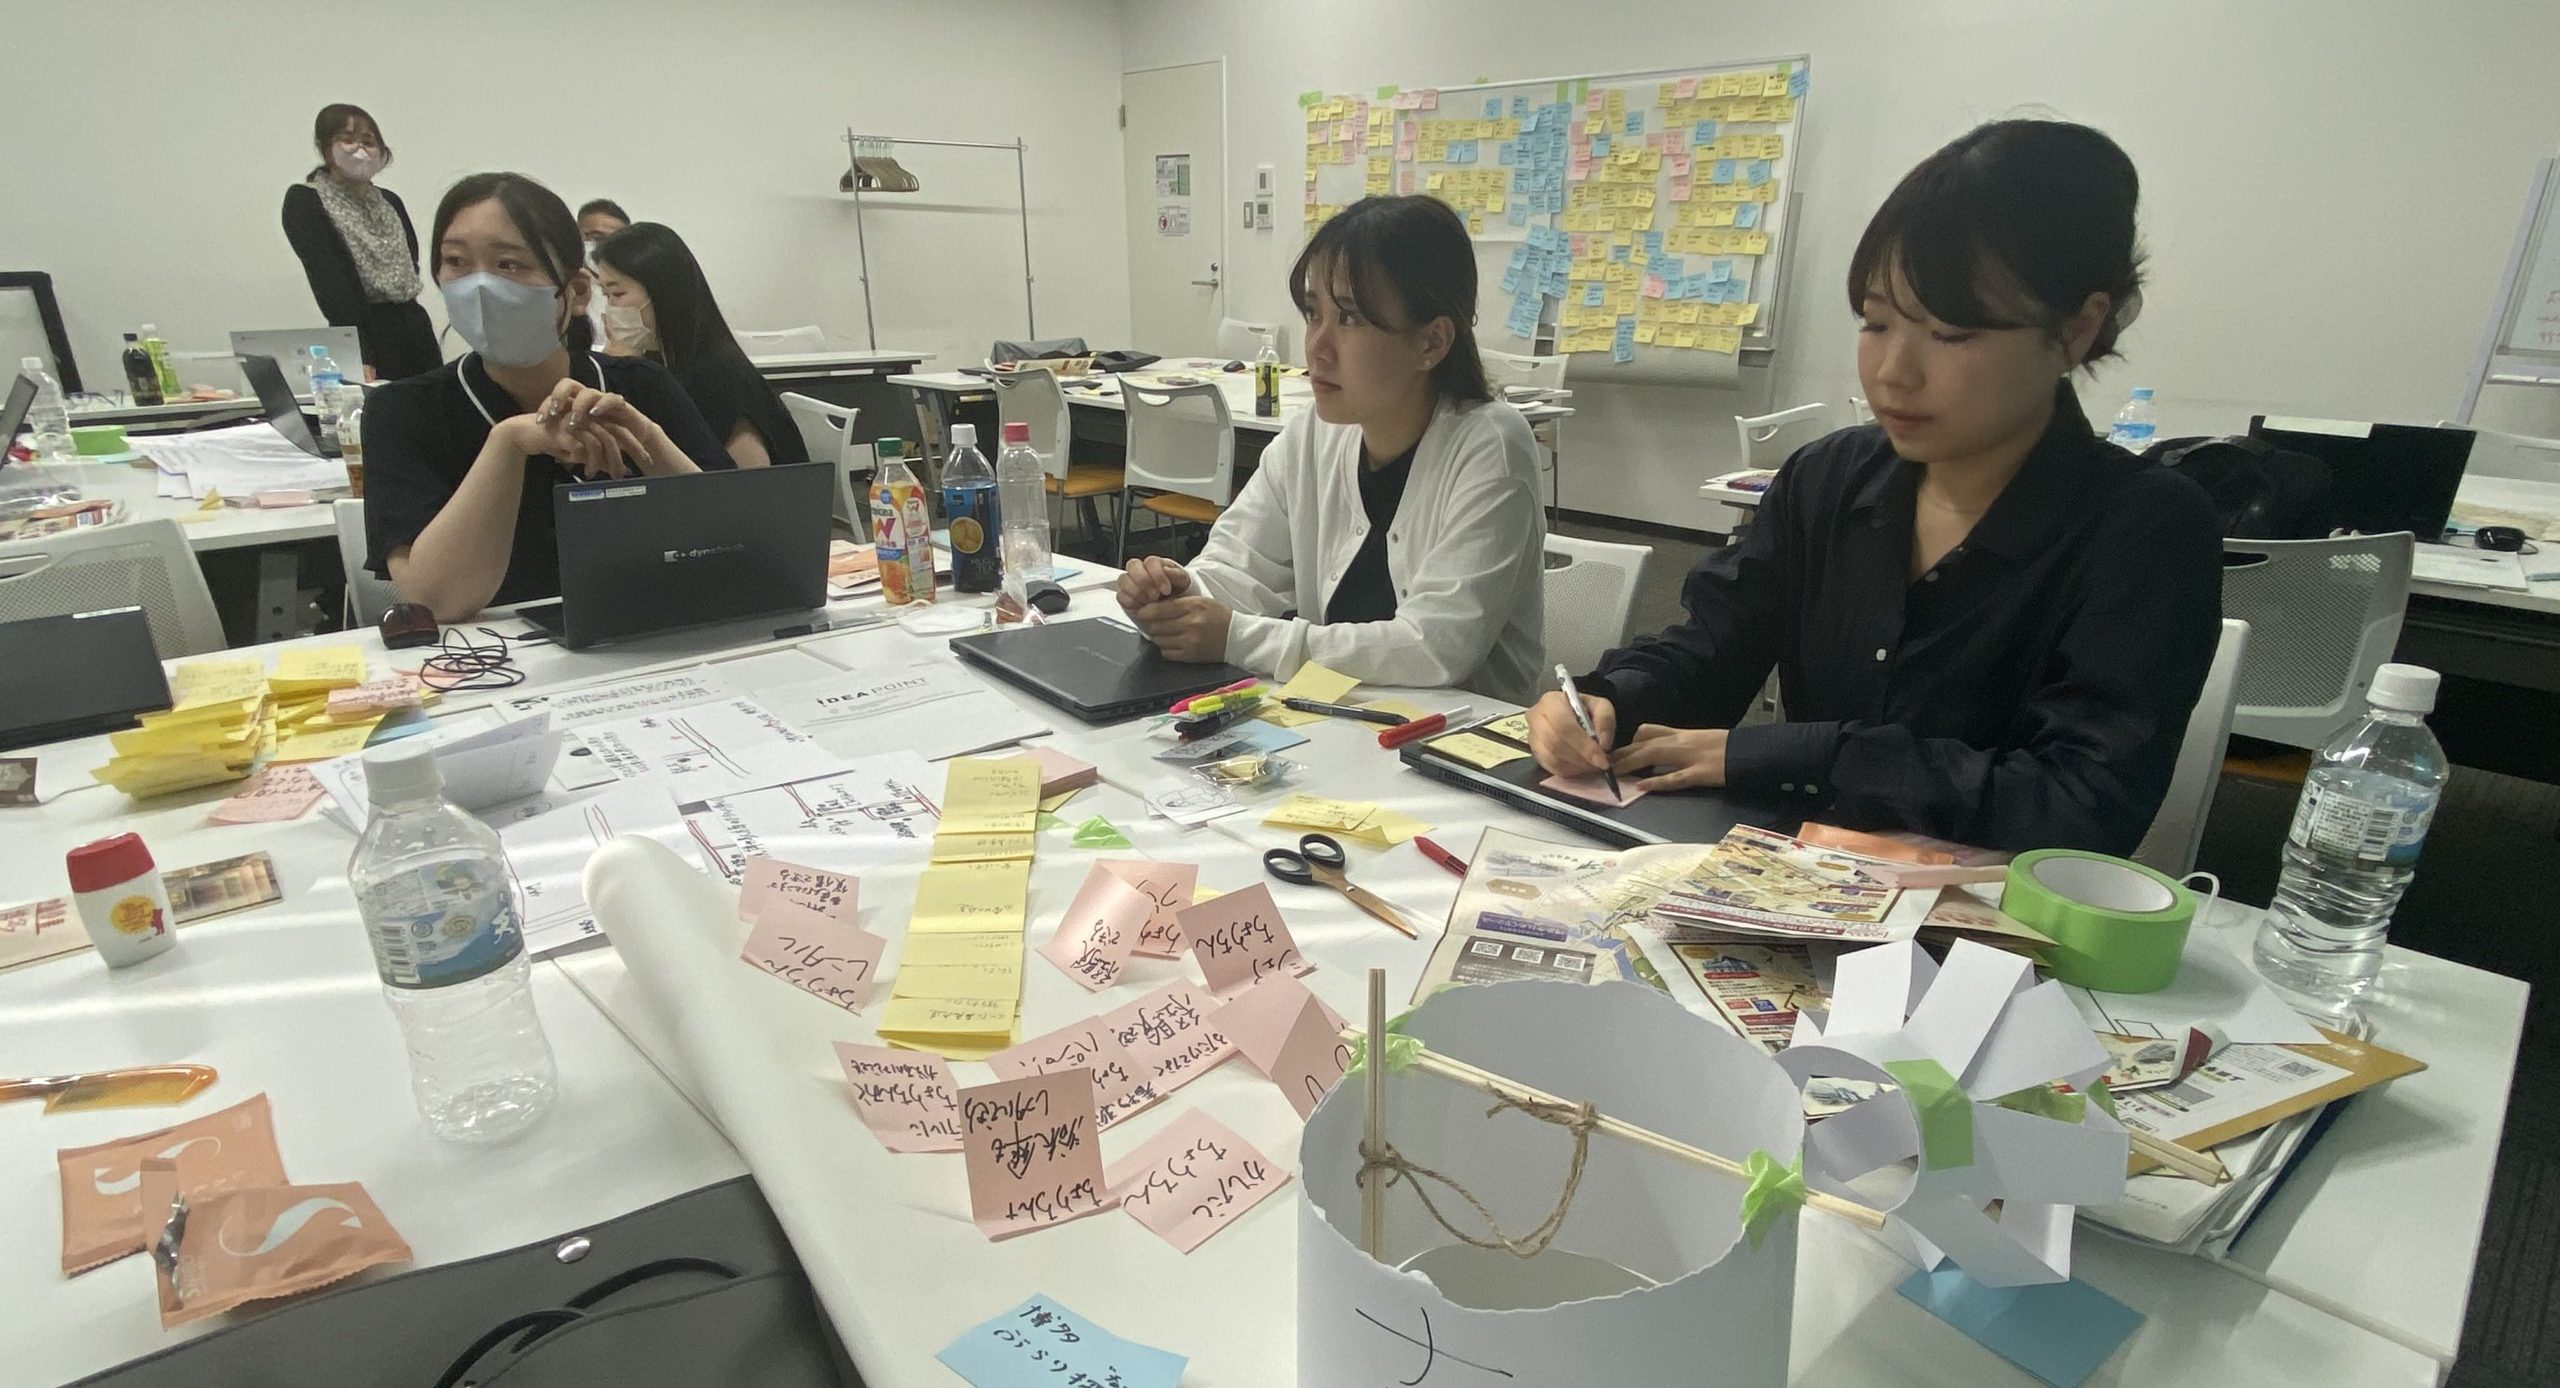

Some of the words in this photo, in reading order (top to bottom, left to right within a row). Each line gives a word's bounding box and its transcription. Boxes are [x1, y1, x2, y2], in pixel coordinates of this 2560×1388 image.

[871, 677, 931, 694] POINT
[1196, 915, 1275, 959] ちょうちん
[777, 937, 869, 982] レンタル
[1124, 1137, 1228, 1208] ちょうちん
[1192, 1159, 1266, 1219] かしだし
[1019, 1304, 1080, 1343] 博多
